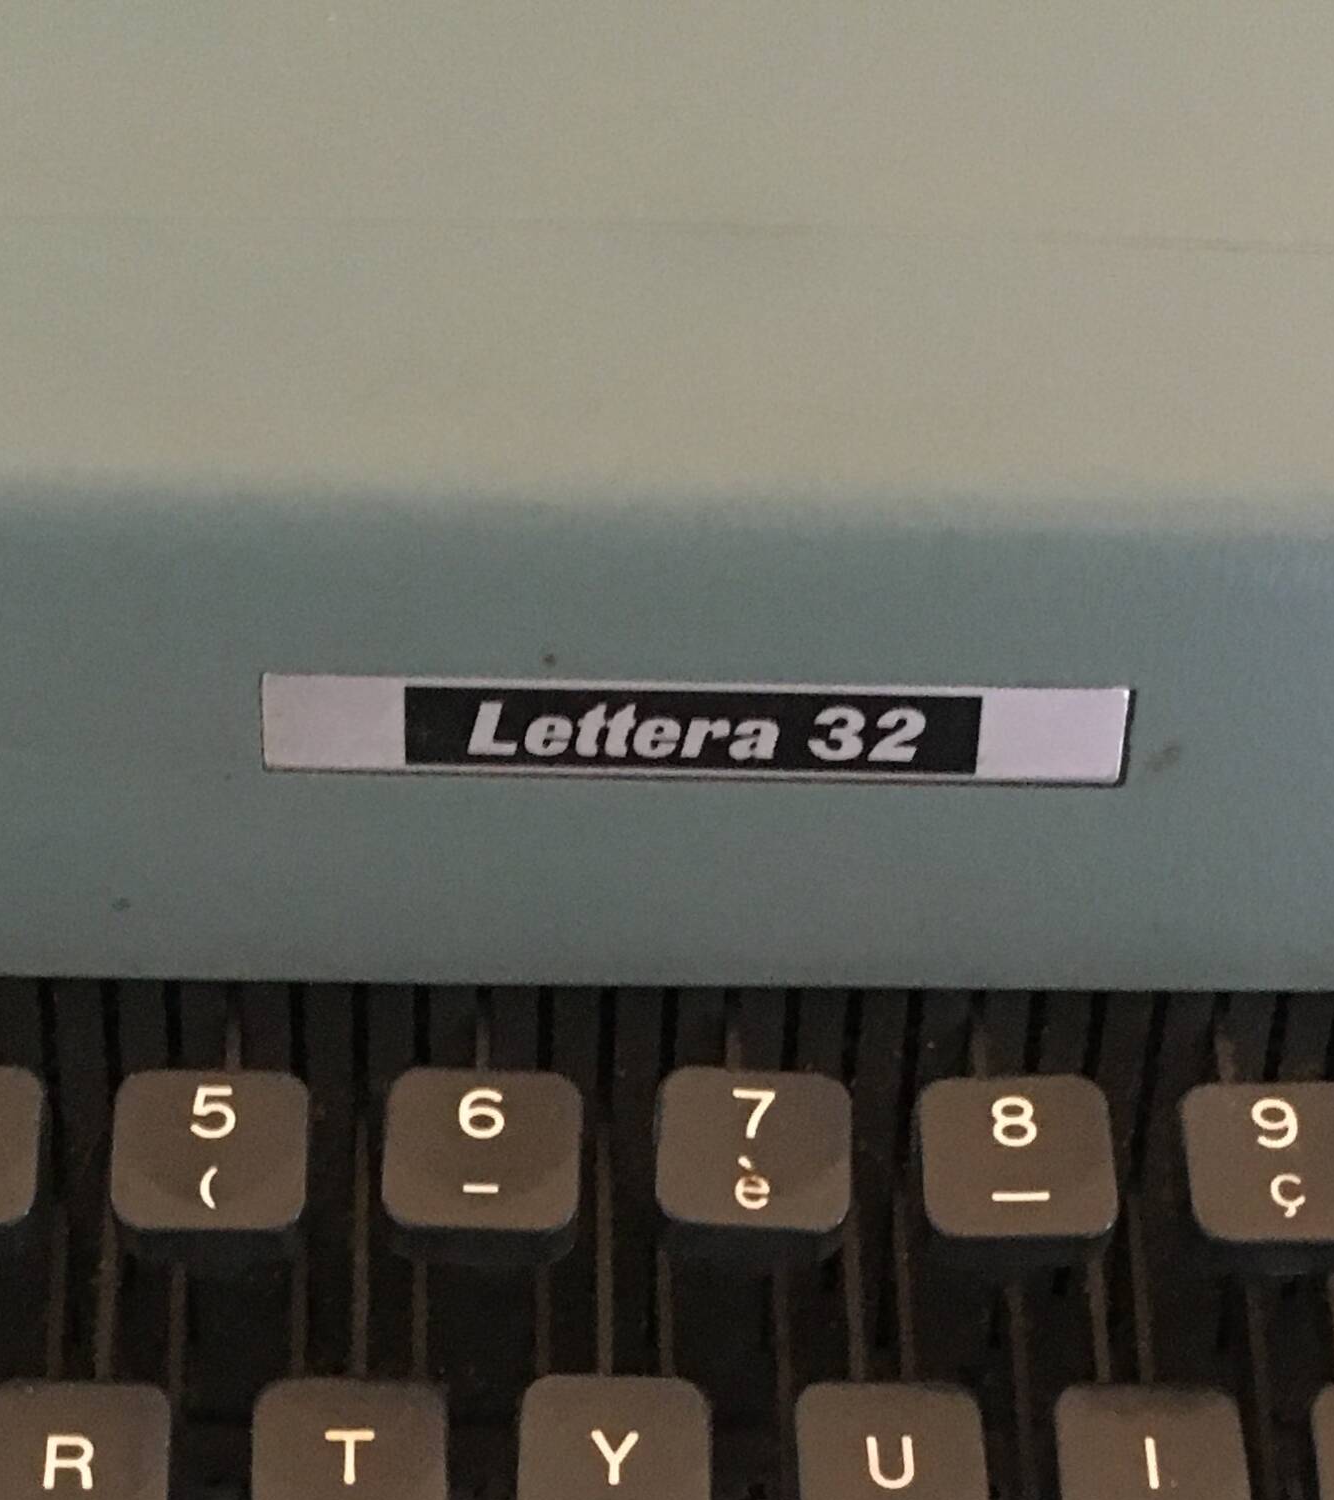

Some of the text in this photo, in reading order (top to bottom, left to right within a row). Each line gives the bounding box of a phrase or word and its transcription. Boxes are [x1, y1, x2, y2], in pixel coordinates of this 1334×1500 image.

[465, 700, 928, 765] Lettera 32
[188, 1083, 238, 1141] 5
[456, 1087, 507, 1141] 6
[730, 1086, 778, 1141] 7
[989, 1094, 1039, 1149] 8
[1249, 1096, 1301, 1151] 9
[197, 1164, 220, 1211] (
[732, 1154, 772, 1212] è
[1268, 1172, 1308, 1220] ç
[40, 1433, 96, 1492] R
[323, 1428, 377, 1487] T
[589, 1427, 641, 1488] Y
[864, 1433, 917, 1492] U
[1142, 1435, 1162, 1492] I
